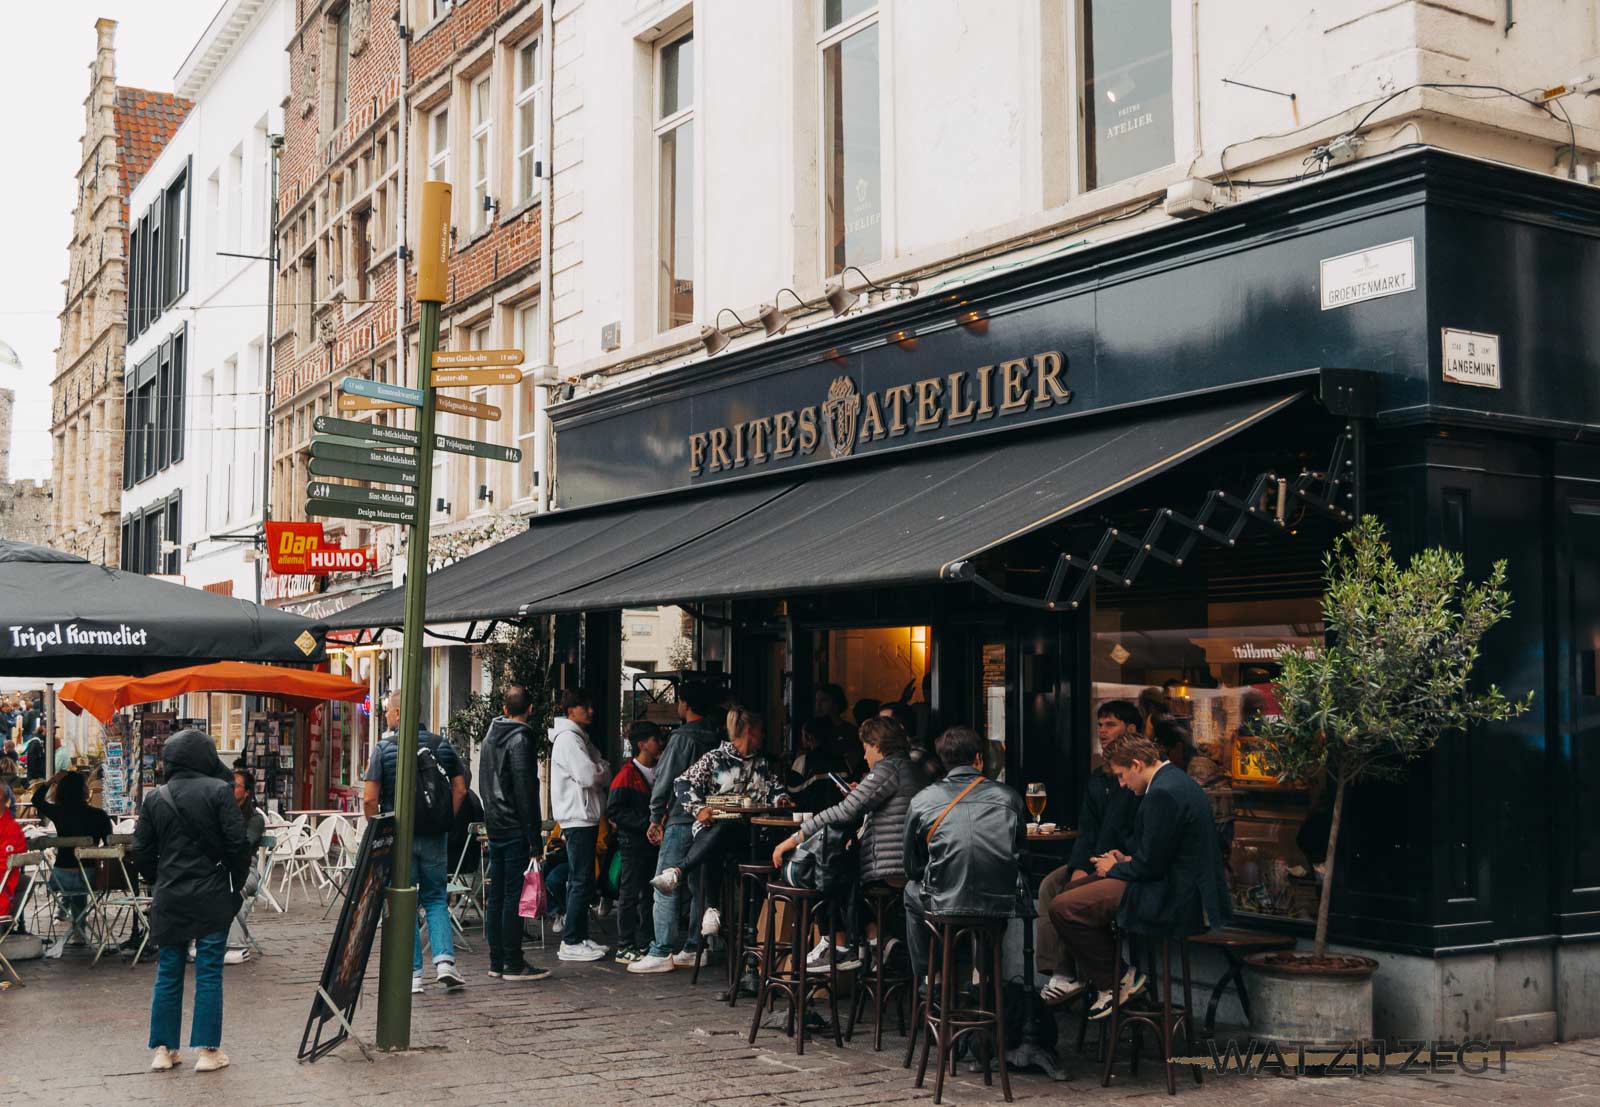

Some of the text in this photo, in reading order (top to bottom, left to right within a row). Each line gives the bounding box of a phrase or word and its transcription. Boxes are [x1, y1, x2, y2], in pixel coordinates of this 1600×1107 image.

[1107, 113, 1153, 139] ATELIER
[1329, 273, 1406, 303] GROENTENMARKT
[1448, 358, 1496, 377] LANGEMUNT
[688, 351, 1071, 475] FRITES ATELIER
[372, 428, 418, 444] Sint-Michielsbrug
[446, 439, 475, 451] Vrijdagmarkt
[370, 452, 416, 466] Sint-Michielskerk
[402, 473, 416, 482] Pand
[368, 492, 404, 503] Sint-Michiels
[357, 508, 414, 520] Design Museum Gent
[311, 552, 364, 567] HUMO
[8, 623, 148, 652] Tripel Karmeliet
